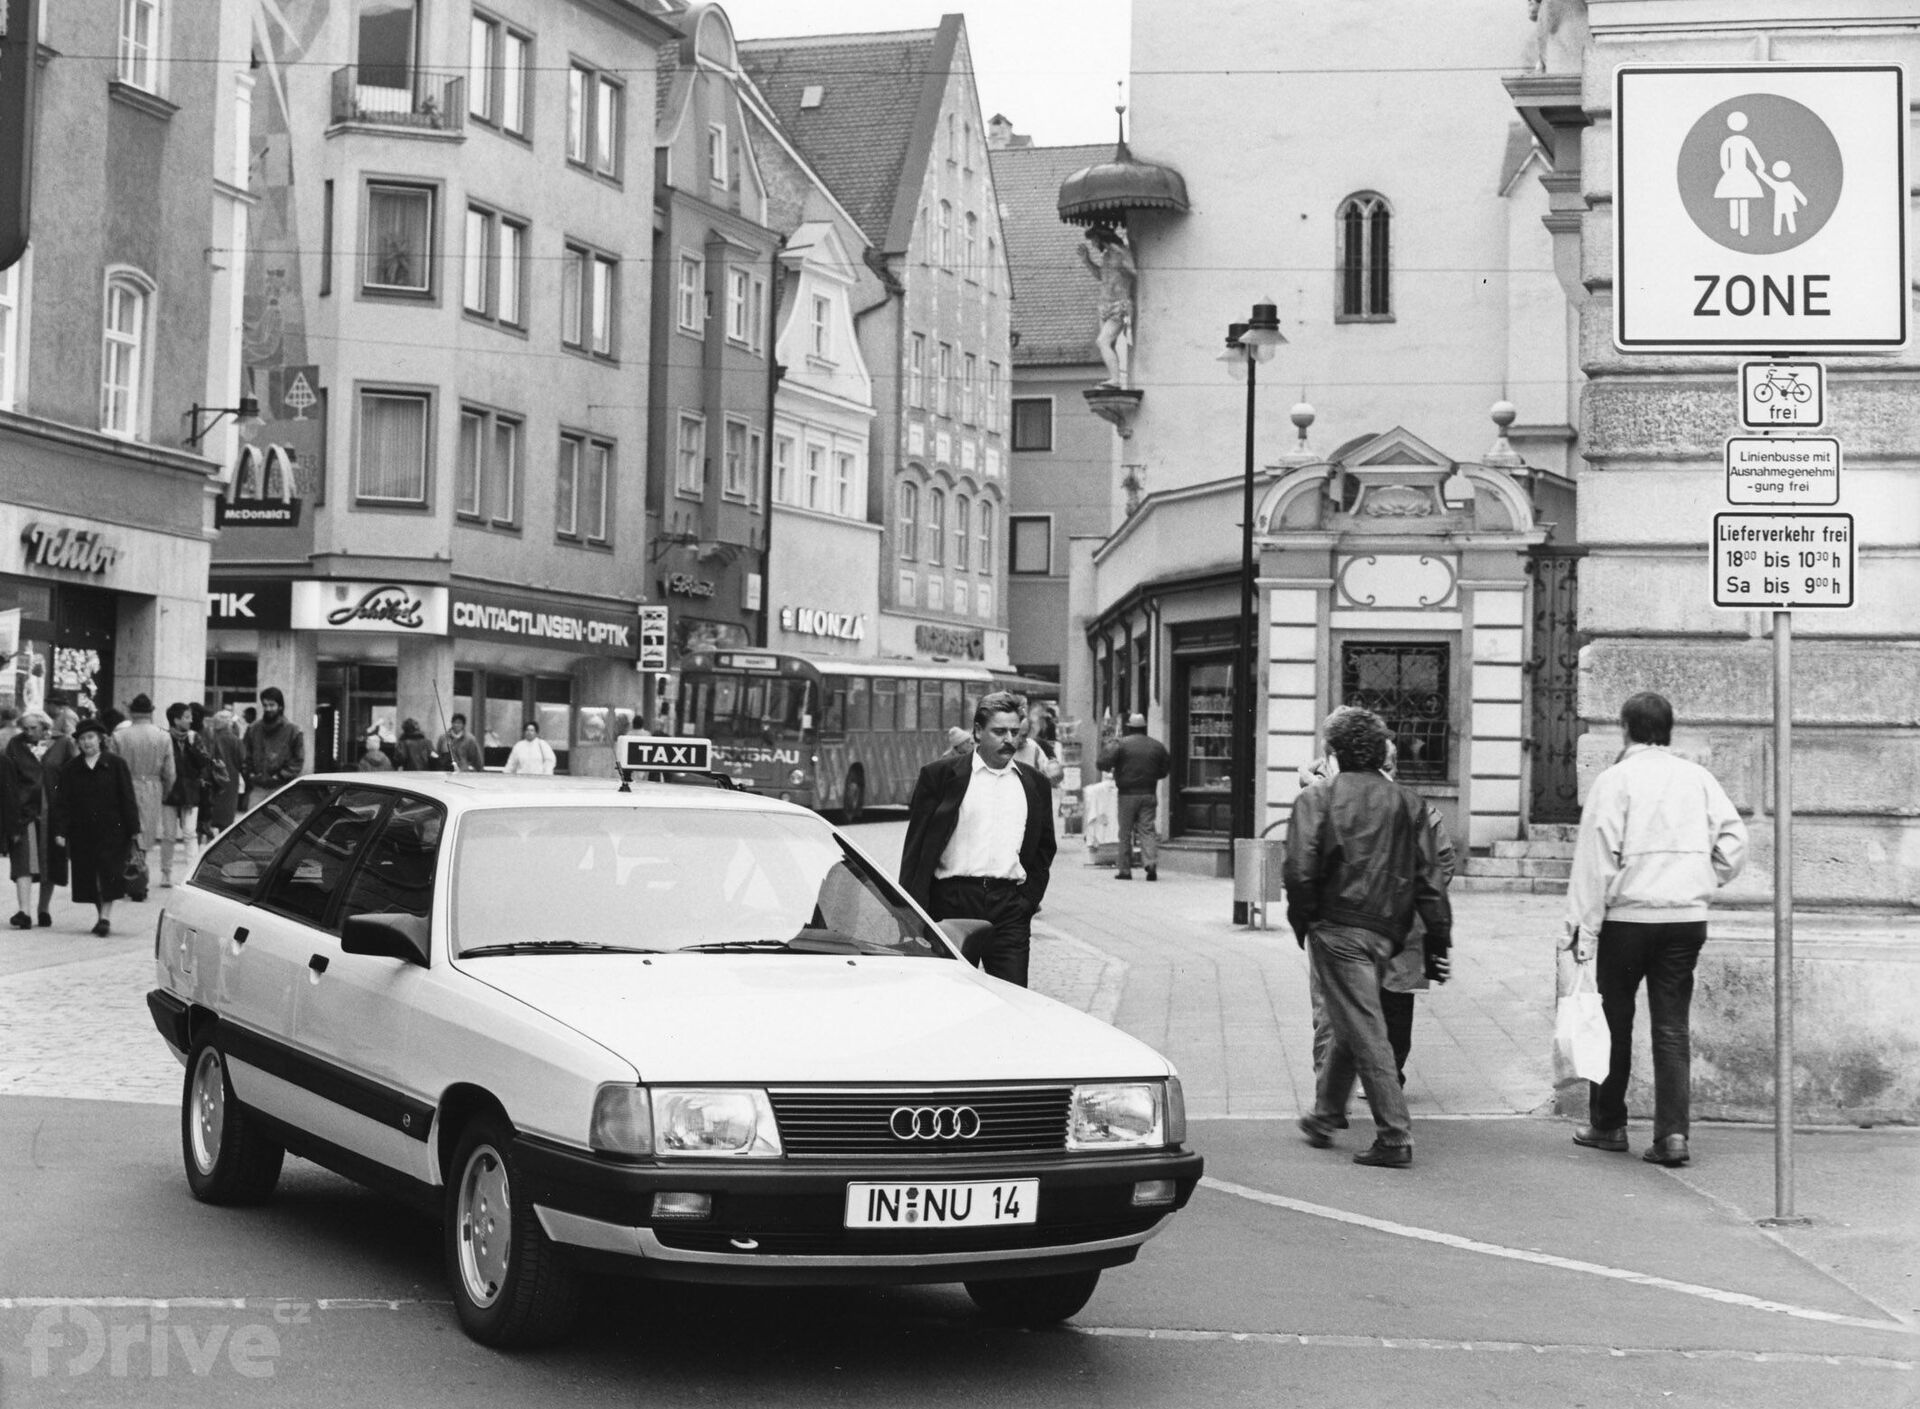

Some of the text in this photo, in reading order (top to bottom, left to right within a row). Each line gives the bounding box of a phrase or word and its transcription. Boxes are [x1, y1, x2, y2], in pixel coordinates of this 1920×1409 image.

[1693, 274, 1831, 317] ZONE
[1769, 404, 1798, 419] frei
[1739, 451, 1831, 463] Linienbusse mit
[1728, 466, 1836, 479] Ausnahmegenehmi
[1789, 481, 1810, 492] frei
[224, 508, 291, 521] McDonald's
[1720, 524, 1848, 543] Lieferverkehr frei
[1764, 551, 1791, 568] bis
[1832, 553, 1841, 569] h
[1726, 576, 1751, 594] Sa
[1764, 576, 1791, 594] bis
[1832, 577, 1841, 595] h
[797, 607, 864, 641] MONZA
[638, 744, 697, 765] TAXI
[992, 1185, 1020, 1220] 14
